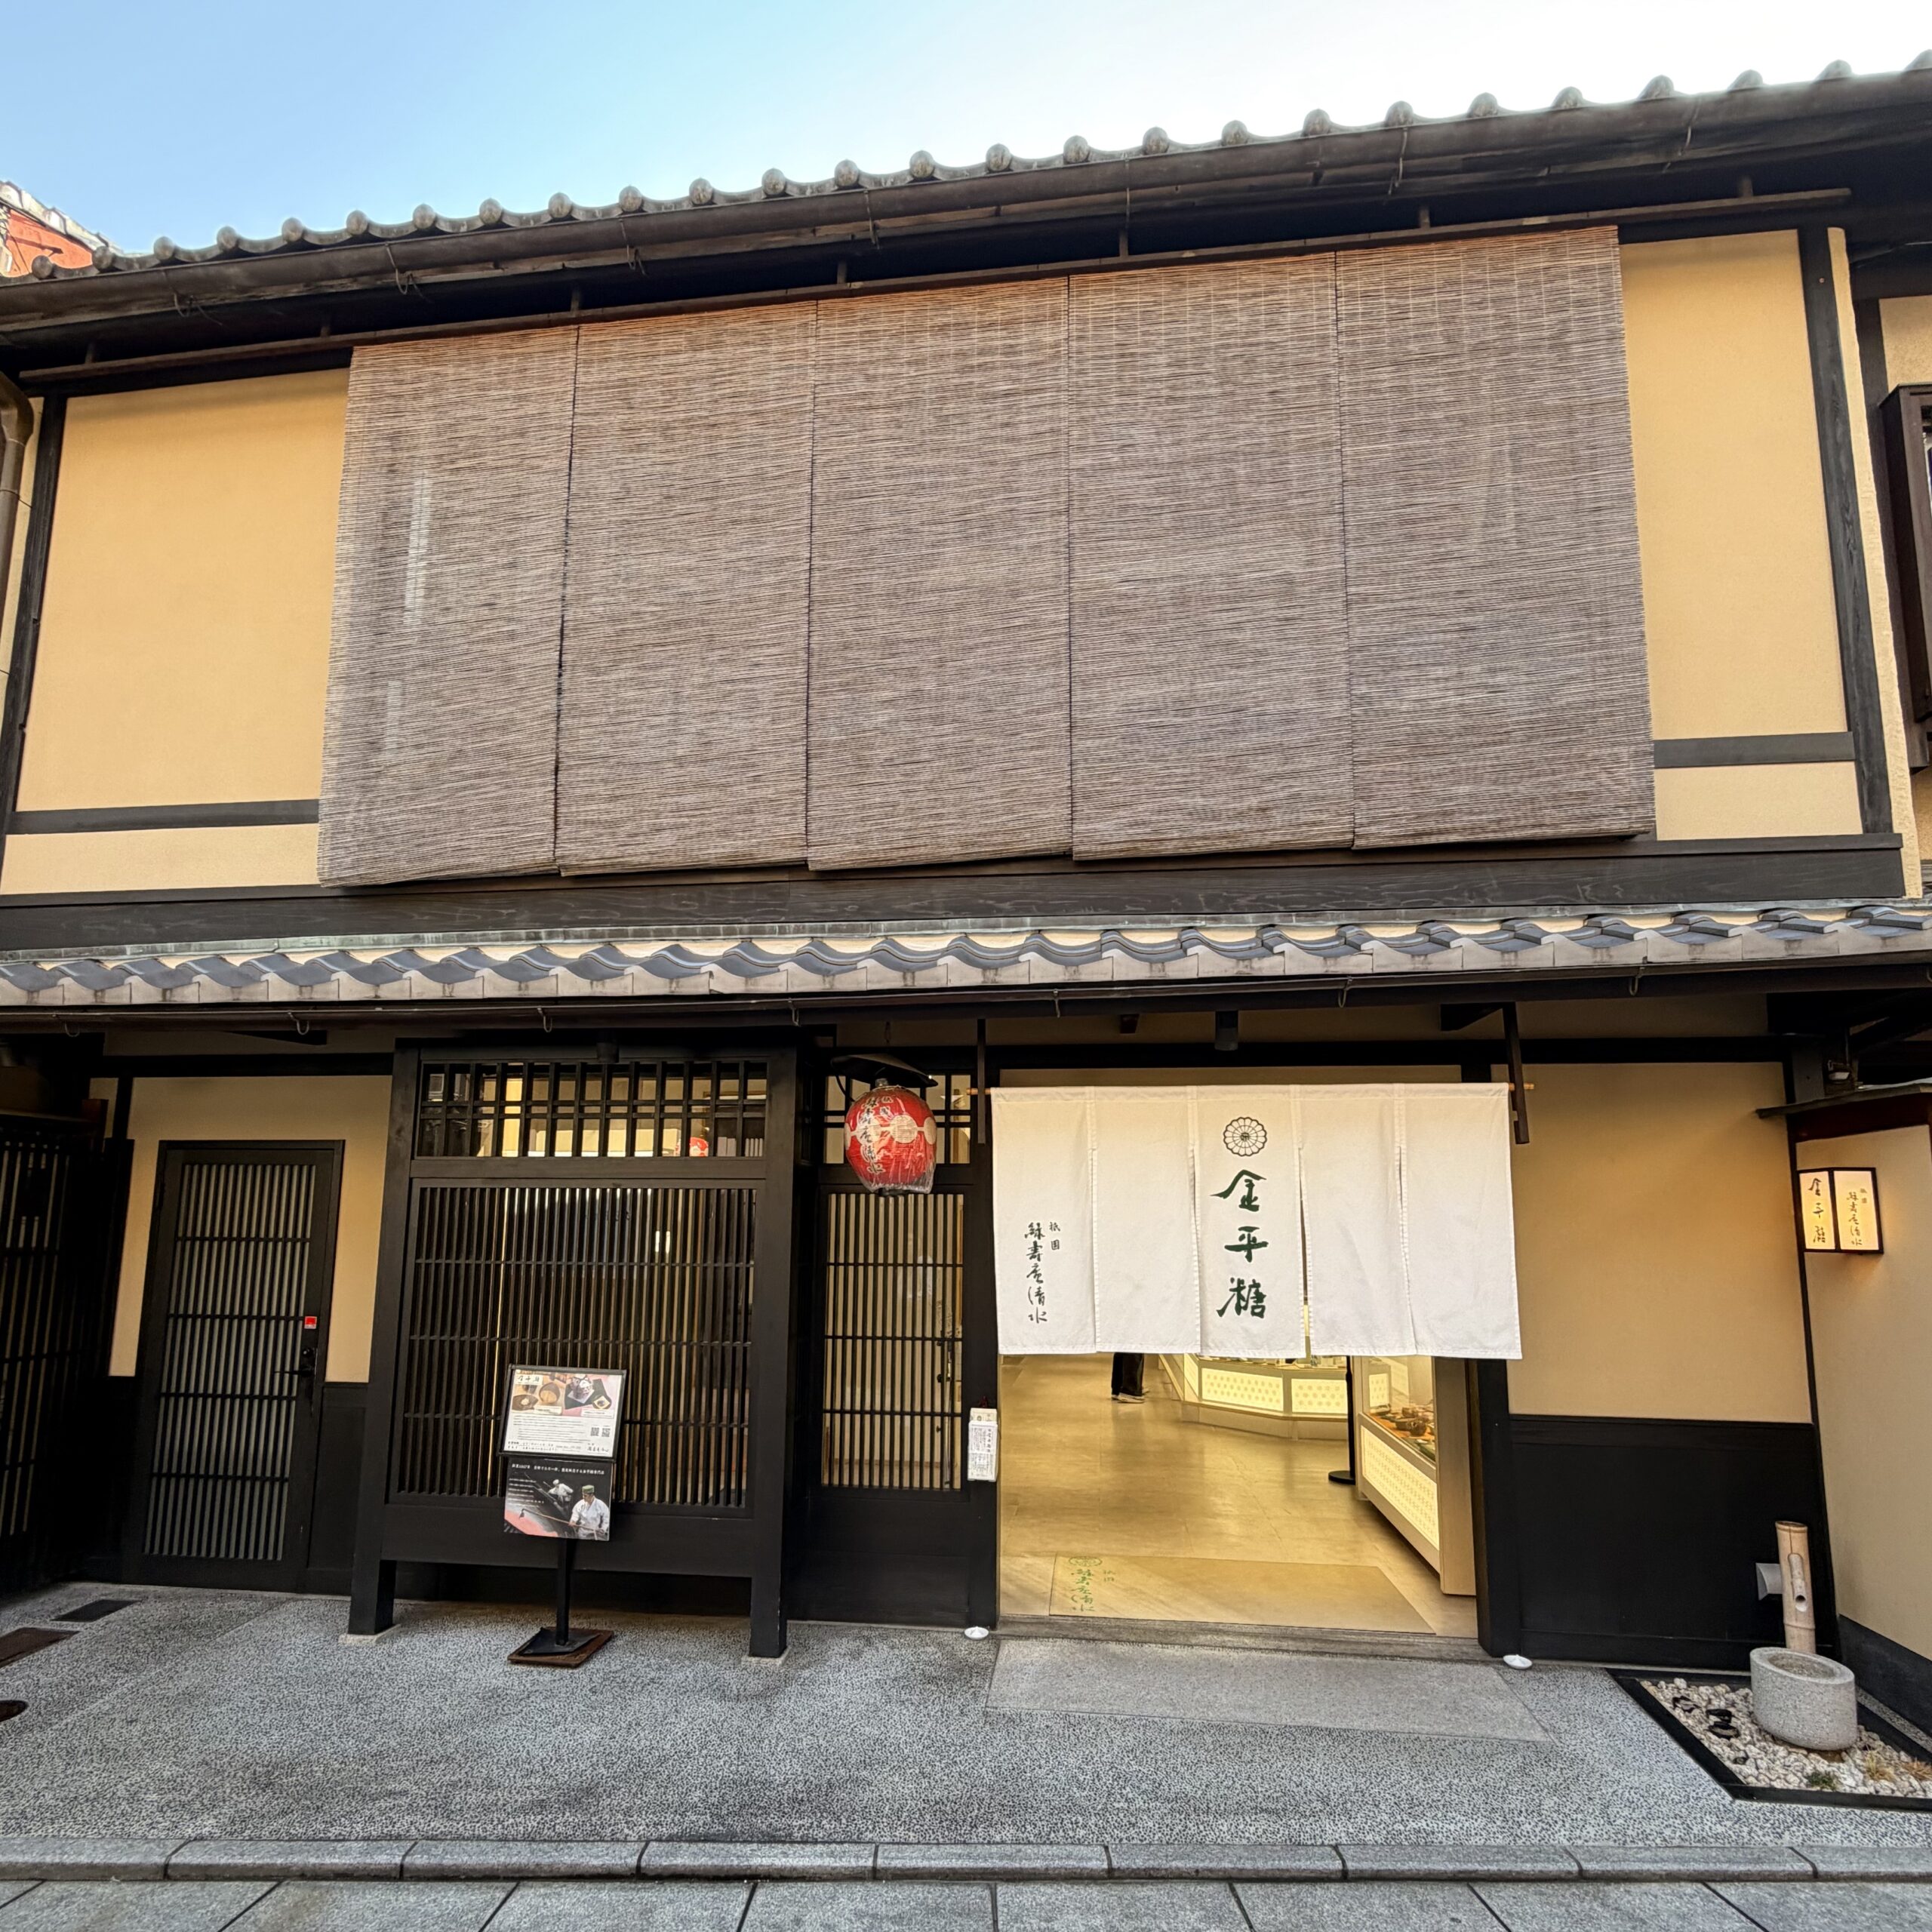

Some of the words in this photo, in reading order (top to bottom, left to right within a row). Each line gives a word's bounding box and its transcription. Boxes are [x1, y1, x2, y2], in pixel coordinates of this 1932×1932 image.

[1210, 1169, 1269, 1319] 金平糖
[1807, 1177, 1826, 1243] 金平糖
